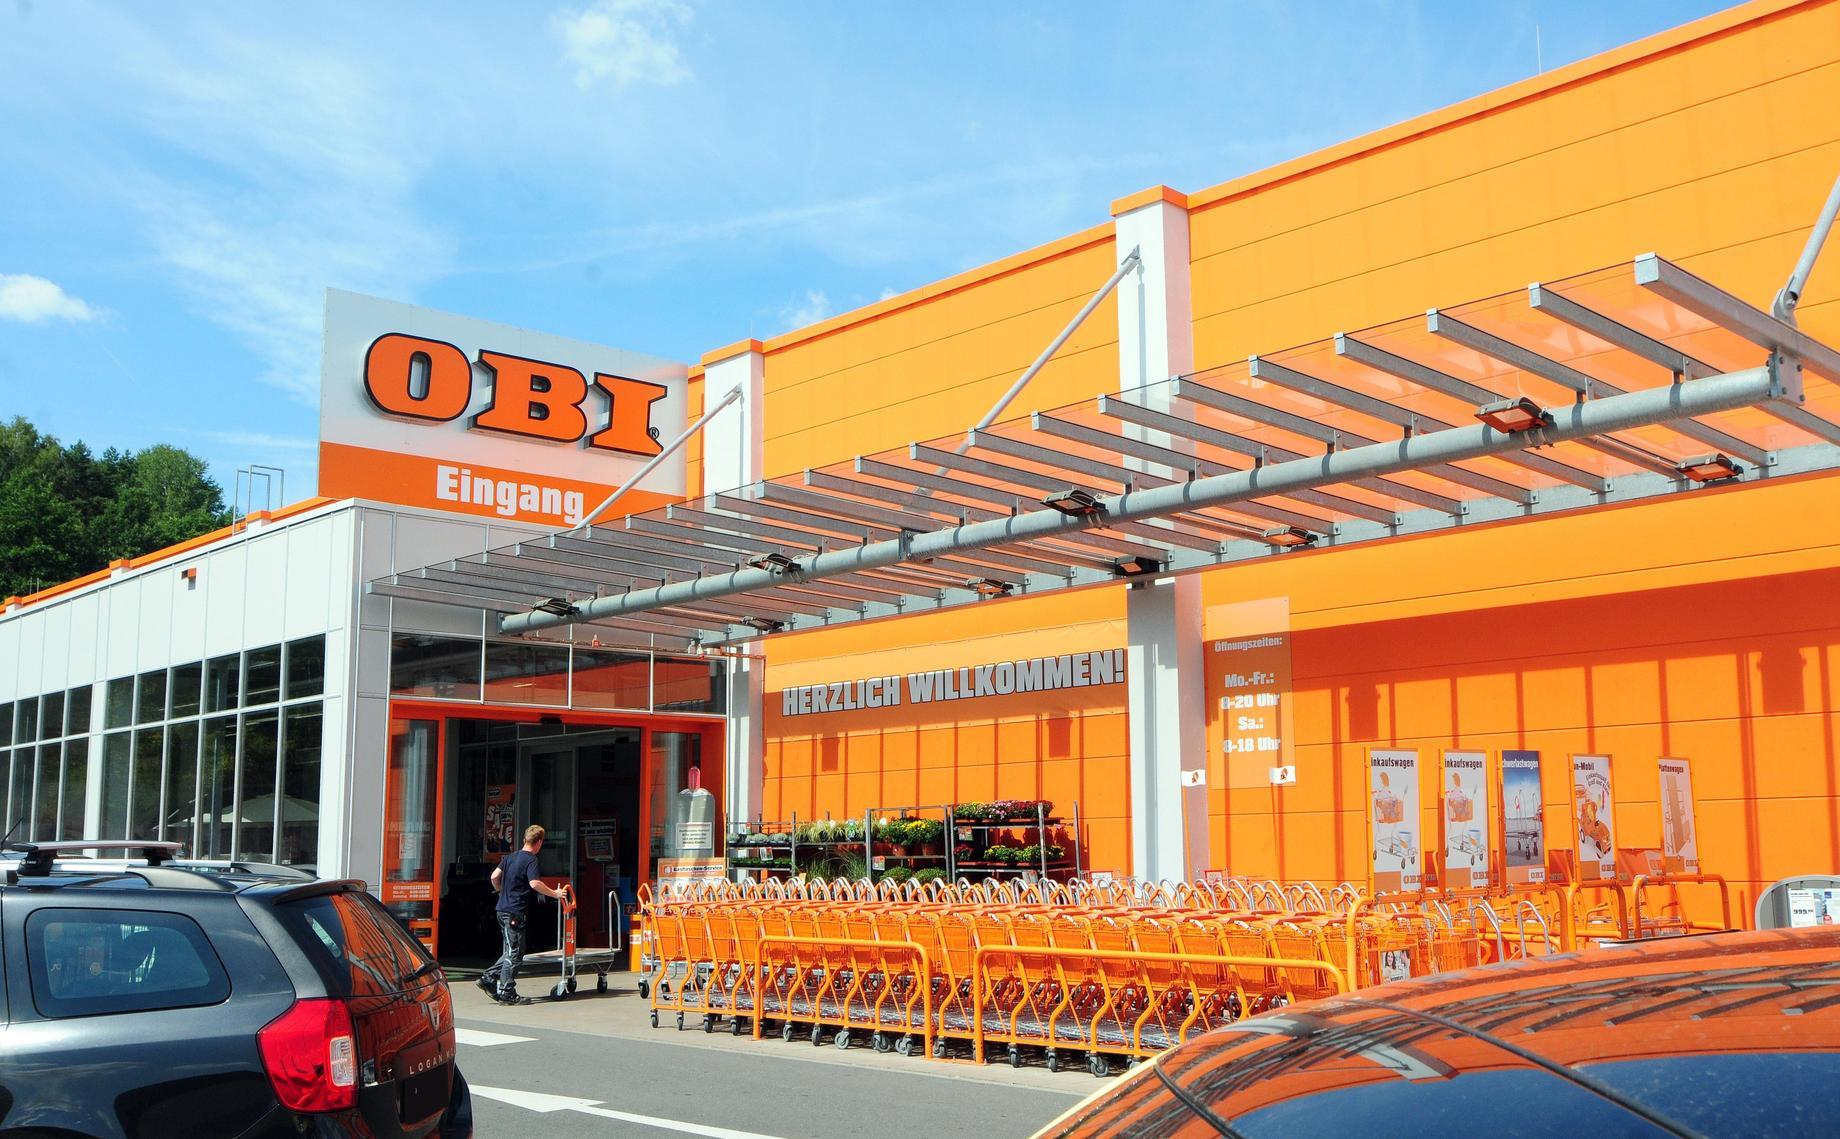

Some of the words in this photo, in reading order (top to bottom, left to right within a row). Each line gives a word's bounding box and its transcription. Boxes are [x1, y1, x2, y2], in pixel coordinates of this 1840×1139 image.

[363, 332, 666, 457] OBI
[436, 465, 585, 525] Eingang
[1214, 636, 1283, 652] Öffnungszeiten:
[782, 674, 901, 717] HERZLICH
[906, 648, 1125, 704] WILLKOMMEN!
[1224, 671, 1275, 688] Mo.-Fr.:
[1221, 695, 1254, 710] 8-20
[1256, 692, 1281, 708] Uhr
[1237, 716, 1264, 731] Sa.:
[1223, 738, 1255, 753] 8-18
[1257, 736, 1281, 751] Uhr
[1371, 757, 1414, 769] inkaufswagen
[1445, 758, 1483, 770] inkaufswagen
[409, 1054, 443, 1075] LOGAN
